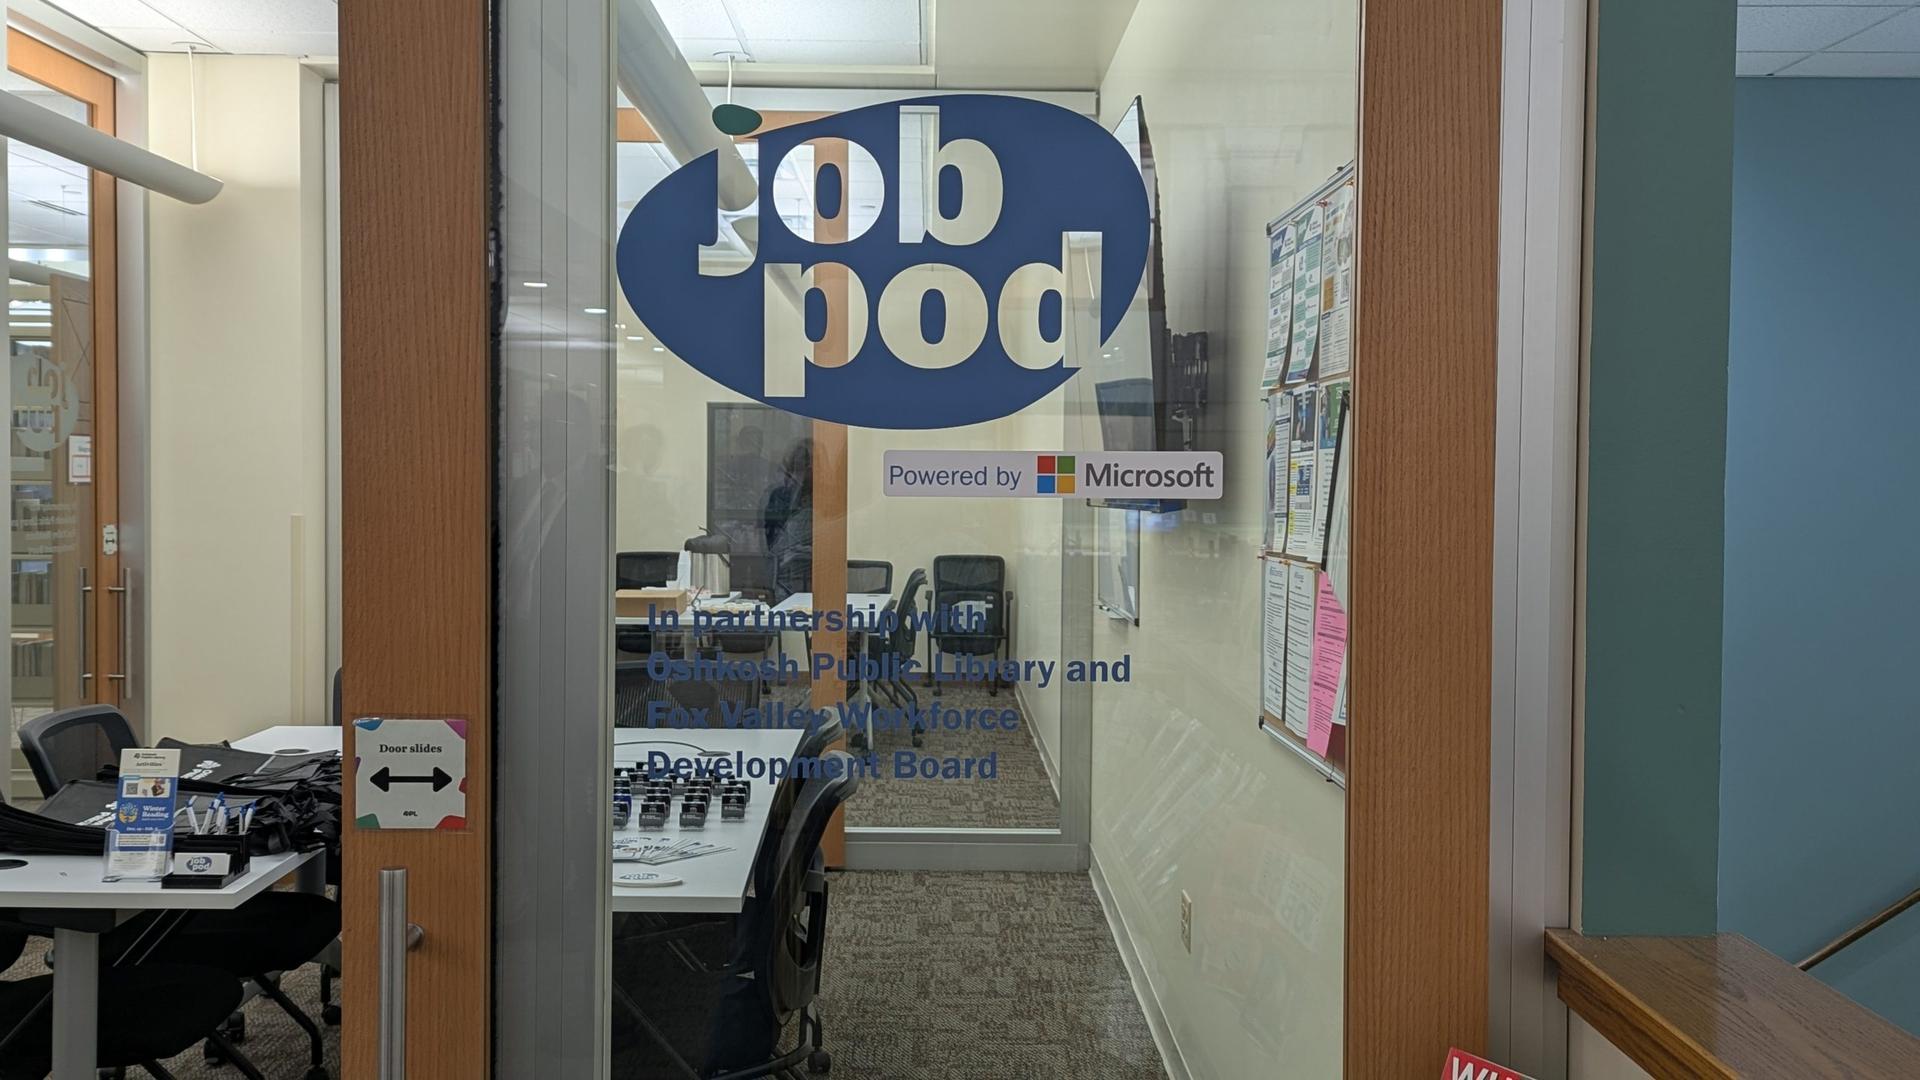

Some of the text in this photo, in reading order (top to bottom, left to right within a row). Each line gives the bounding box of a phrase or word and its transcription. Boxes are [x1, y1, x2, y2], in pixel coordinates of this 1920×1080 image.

[698, 104, 1004, 277] job
[763, 230, 1103, 398] pod
[889, 465, 1022, 491] Powered by
[1085, 462, 1214, 488] Microsoft
[648, 604, 986, 638] In partnership with
[647, 653, 1132, 688] Oshkosh Public Library and
[647, 702, 1019, 736] Fox Valley Workforce
[379, 744, 442, 753] Door slides
[647, 751, 998, 785] Development Board
